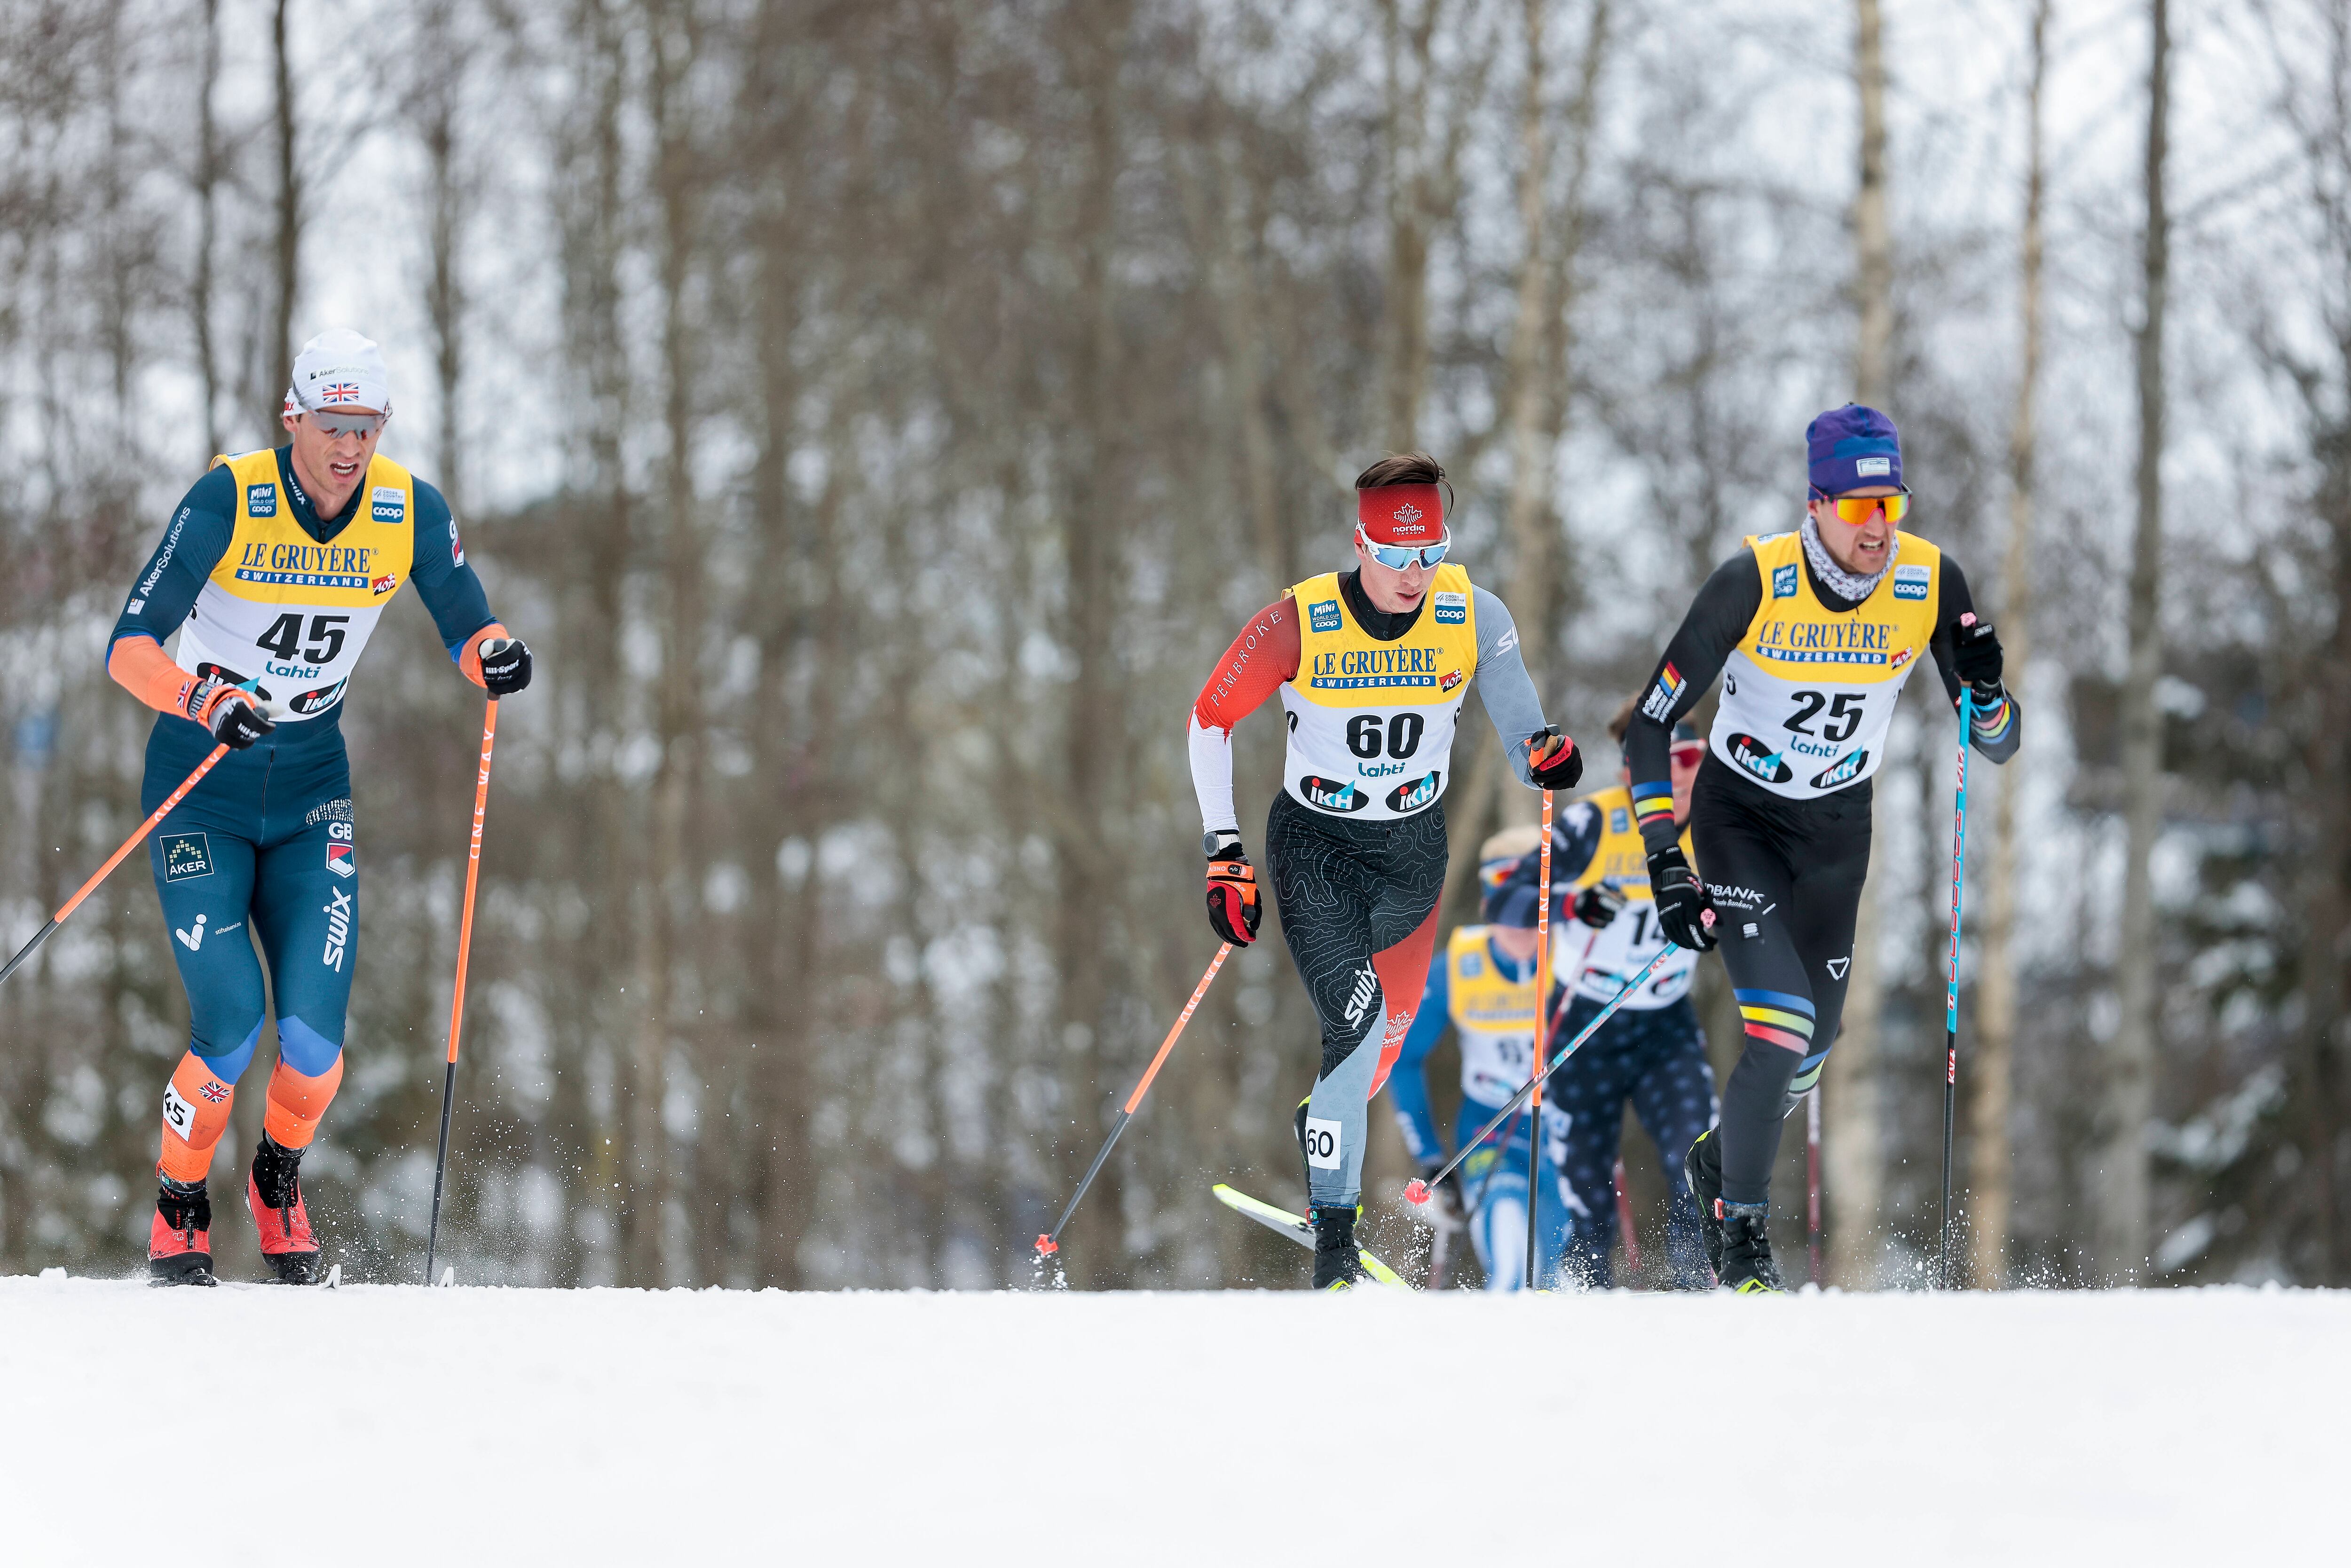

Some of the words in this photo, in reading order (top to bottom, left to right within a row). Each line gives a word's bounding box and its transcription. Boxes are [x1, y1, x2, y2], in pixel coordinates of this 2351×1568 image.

[252, 505, 272, 514] coop
[373, 507, 403, 519] coop
[139, 506, 191, 597] AkerSolutions
[240, 543, 267, 567] LE
[241, 570, 363, 587] SWITZERLAND
[373, 577, 396, 593] AOP
[1894, 583, 1927, 597] coop
[1436, 610, 1465, 620] coop
[256, 613, 351, 664] 45
[1759, 620, 1784, 645] LE
[1210, 610, 1282, 707] PEMBROKE
[1761, 647, 1882, 663] SWITZERLAND
[1313, 653, 1336, 676] LE
[1316, 677, 1430, 687] SWITZERLAND
[1441, 675, 1462, 689] AOP
[1783, 691, 1867, 741] 25
[1347, 713, 1424, 759] 60
[1546, 753, 1566, 768] AUCLAIR
[328, 822, 352, 841] GB
[170, 860, 207, 875] AKER
[1727, 898, 1754, 910] Bankers
[1381, 1033, 1405, 1045] ordiq
[165, 1092, 185, 1126] 45
[1307, 1128, 1334, 1158] 60
